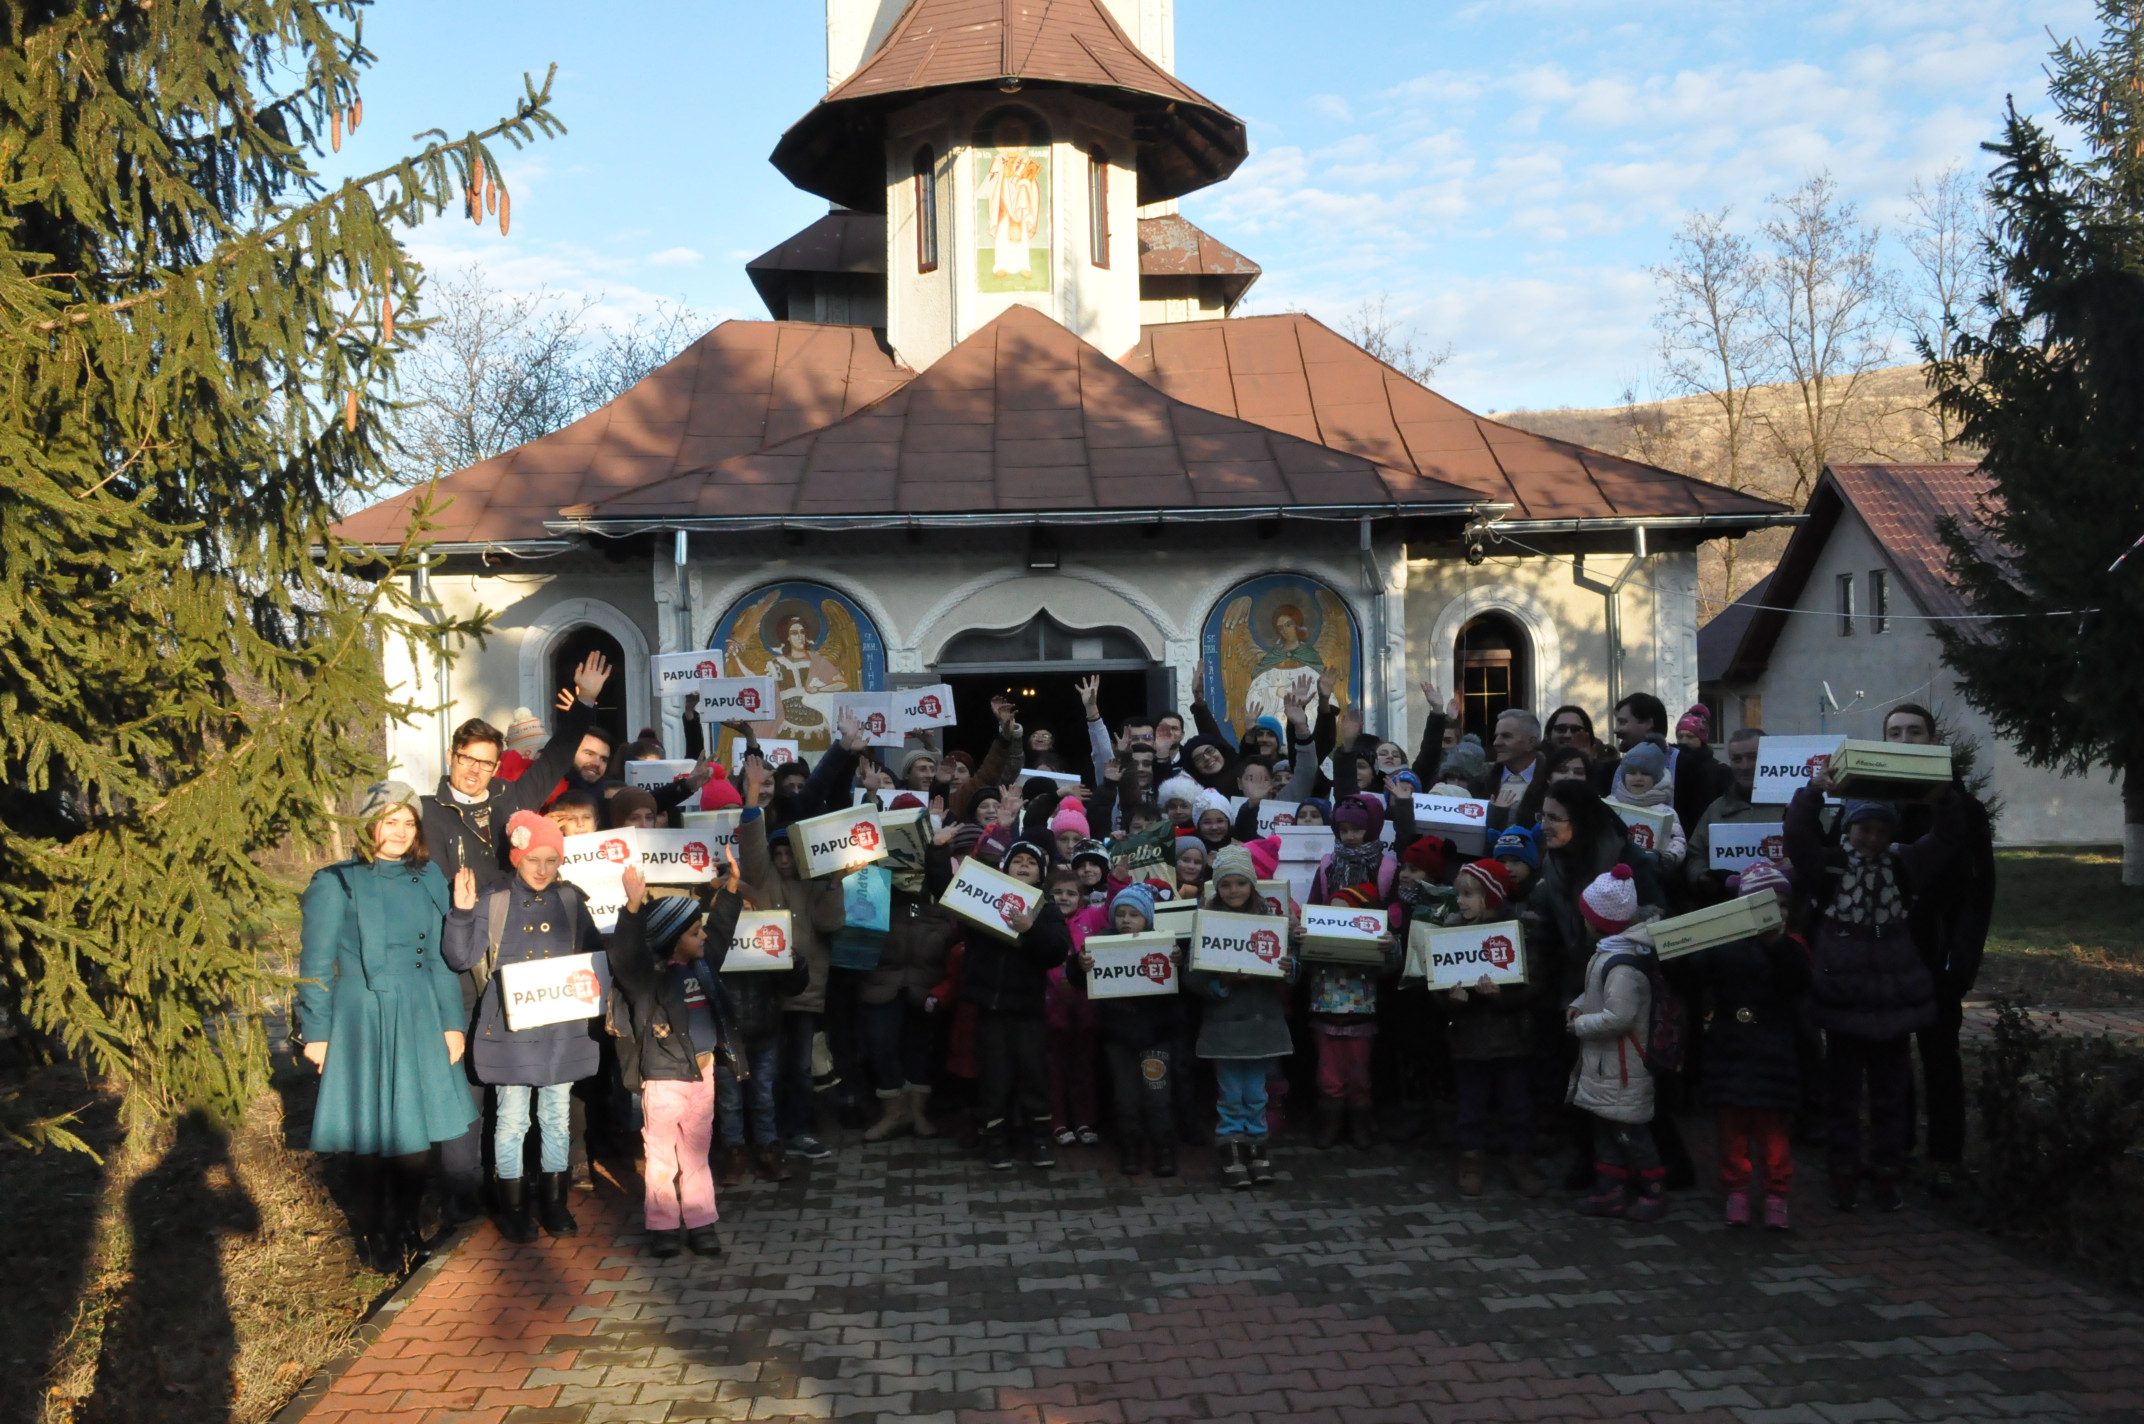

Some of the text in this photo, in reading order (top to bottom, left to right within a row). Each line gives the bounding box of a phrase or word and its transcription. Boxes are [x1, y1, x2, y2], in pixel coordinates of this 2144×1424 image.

[704, 696, 756, 708] PAPUCEI
[1415, 802, 1479, 817] PAPUCEI
[811, 830, 874, 856] PAPUCEI
[562, 846, 625, 865] APUCEI
[642, 851, 705, 866] PAPUCEI
[1307, 917, 1375, 931] PAPUCEI
[730, 935, 780, 951] PUCEI
[1202, 935, 1275, 957] PAPUCEI
[1432, 946, 1509, 967] PAPUCEI
[1093, 963, 1165, 979] PAPUCEI
